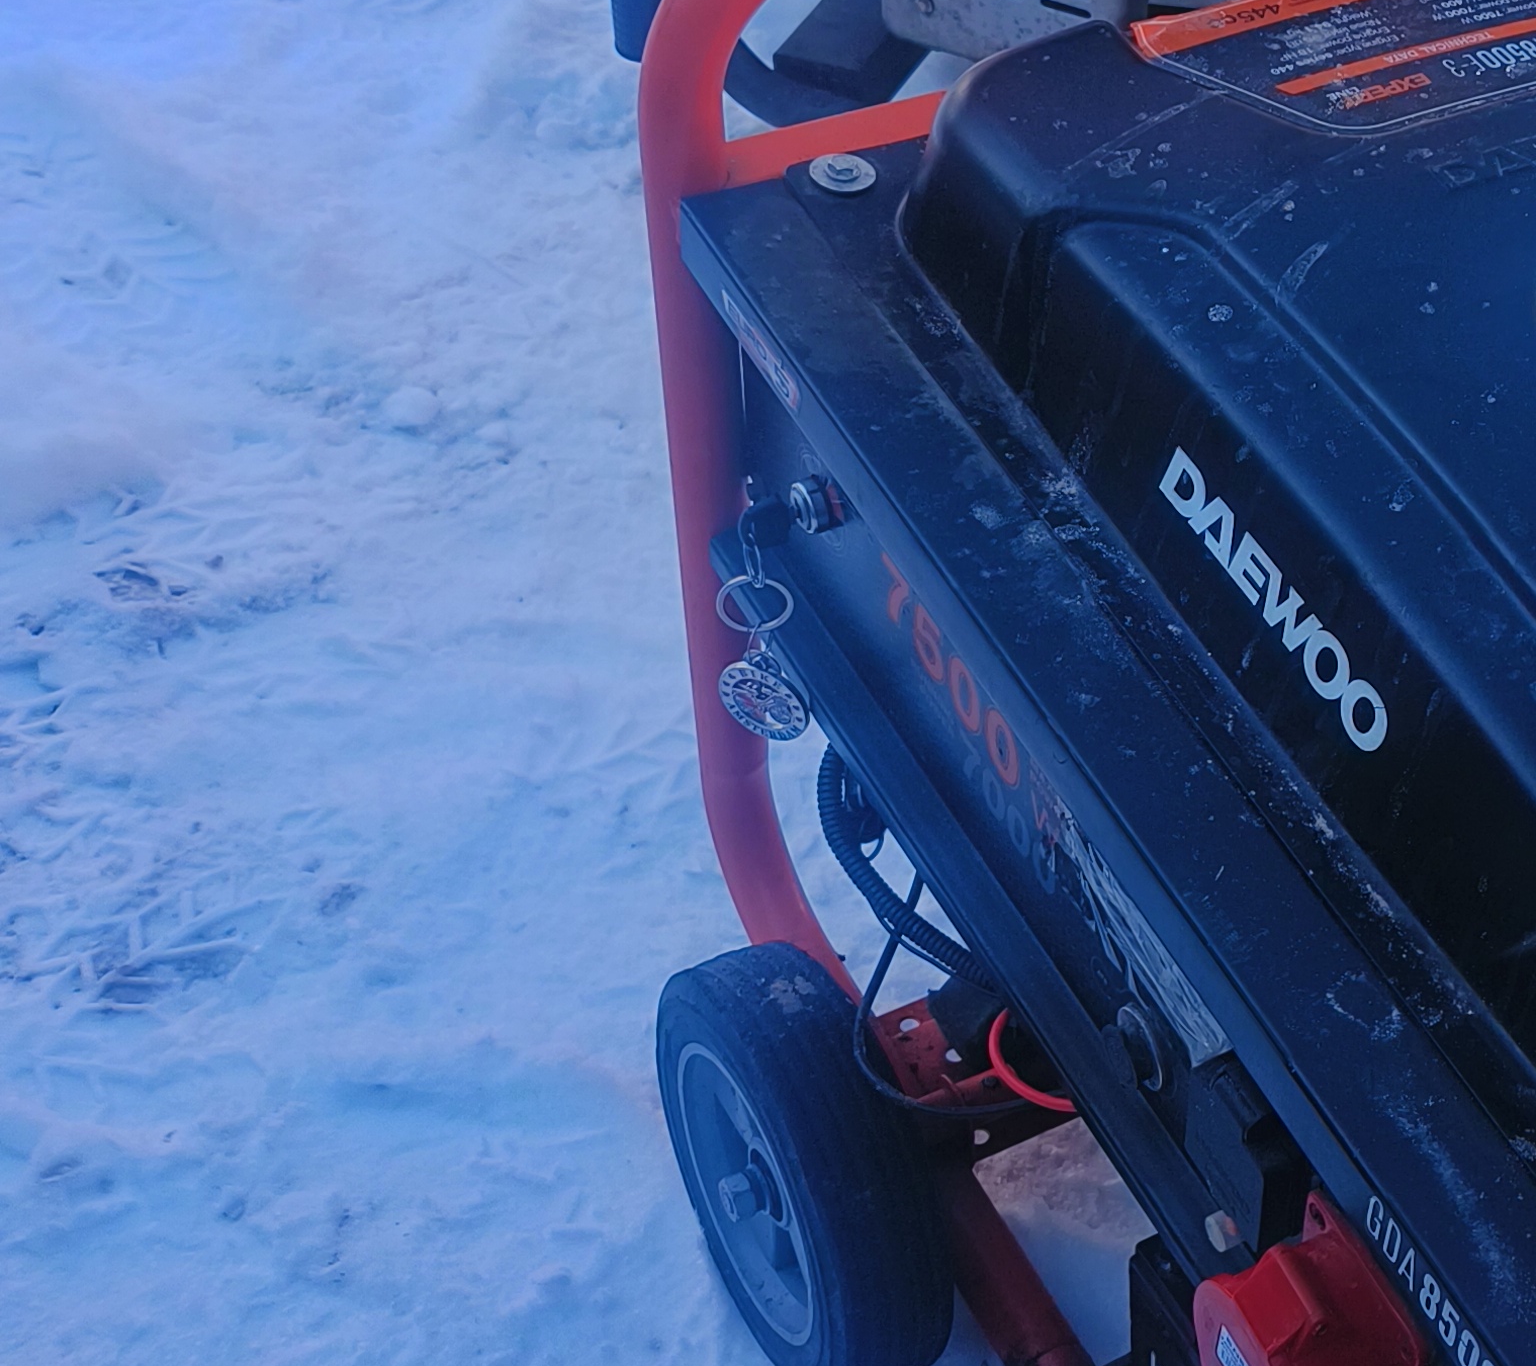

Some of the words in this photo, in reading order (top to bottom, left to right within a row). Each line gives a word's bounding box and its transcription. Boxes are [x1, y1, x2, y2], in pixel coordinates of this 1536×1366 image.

[1446, 5, 1476, 18] 7000
[1418, 31, 1494, 53] TECHNICAL
[1382, 48, 1419, 64] DATA
[1158, 445, 1388, 752] DAEWOO
[738, 669, 783, 690] BIKE
[880, 550, 1021, 789] 7500
[960, 733, 1056, 895] 7000
